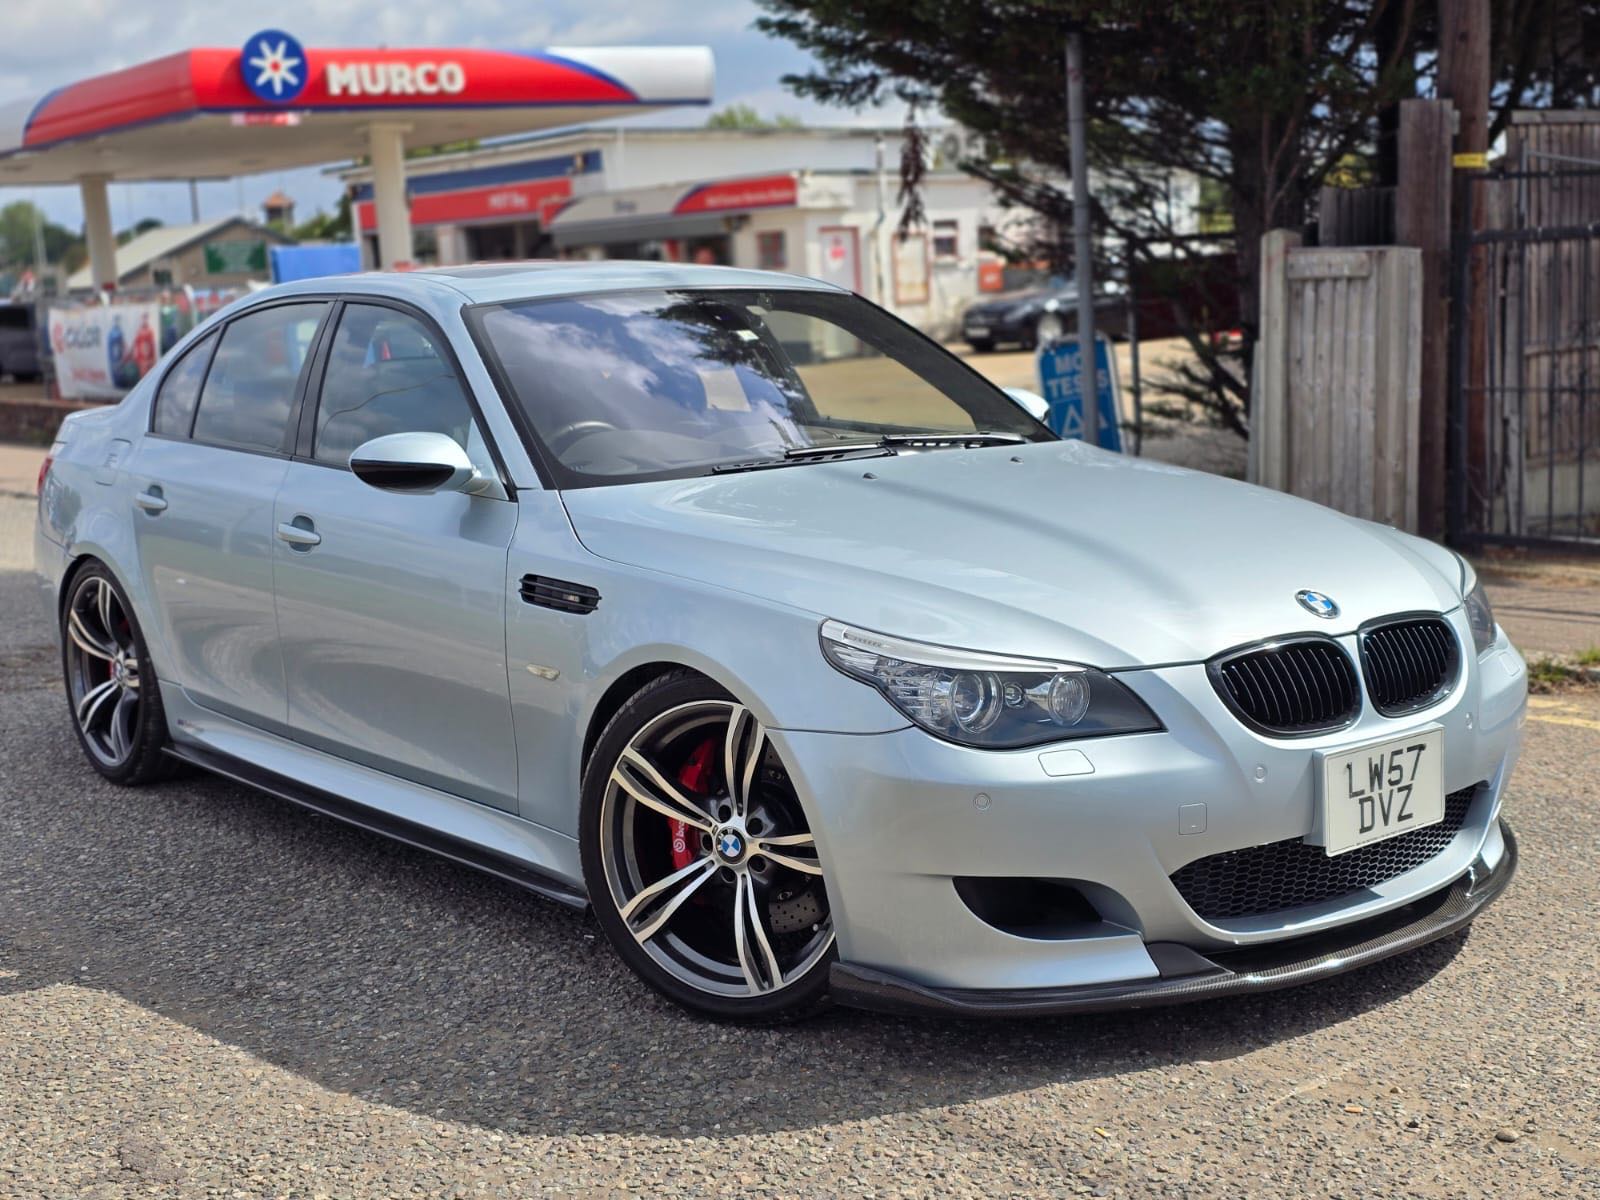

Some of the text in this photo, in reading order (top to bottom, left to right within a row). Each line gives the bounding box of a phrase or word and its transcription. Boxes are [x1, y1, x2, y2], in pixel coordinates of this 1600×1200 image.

[326, 62, 465, 96] MURCO
[1055, 351, 1085, 375] MO
[1346, 743, 1426, 799] LW57
[1358, 783, 1413, 834] DVZ
